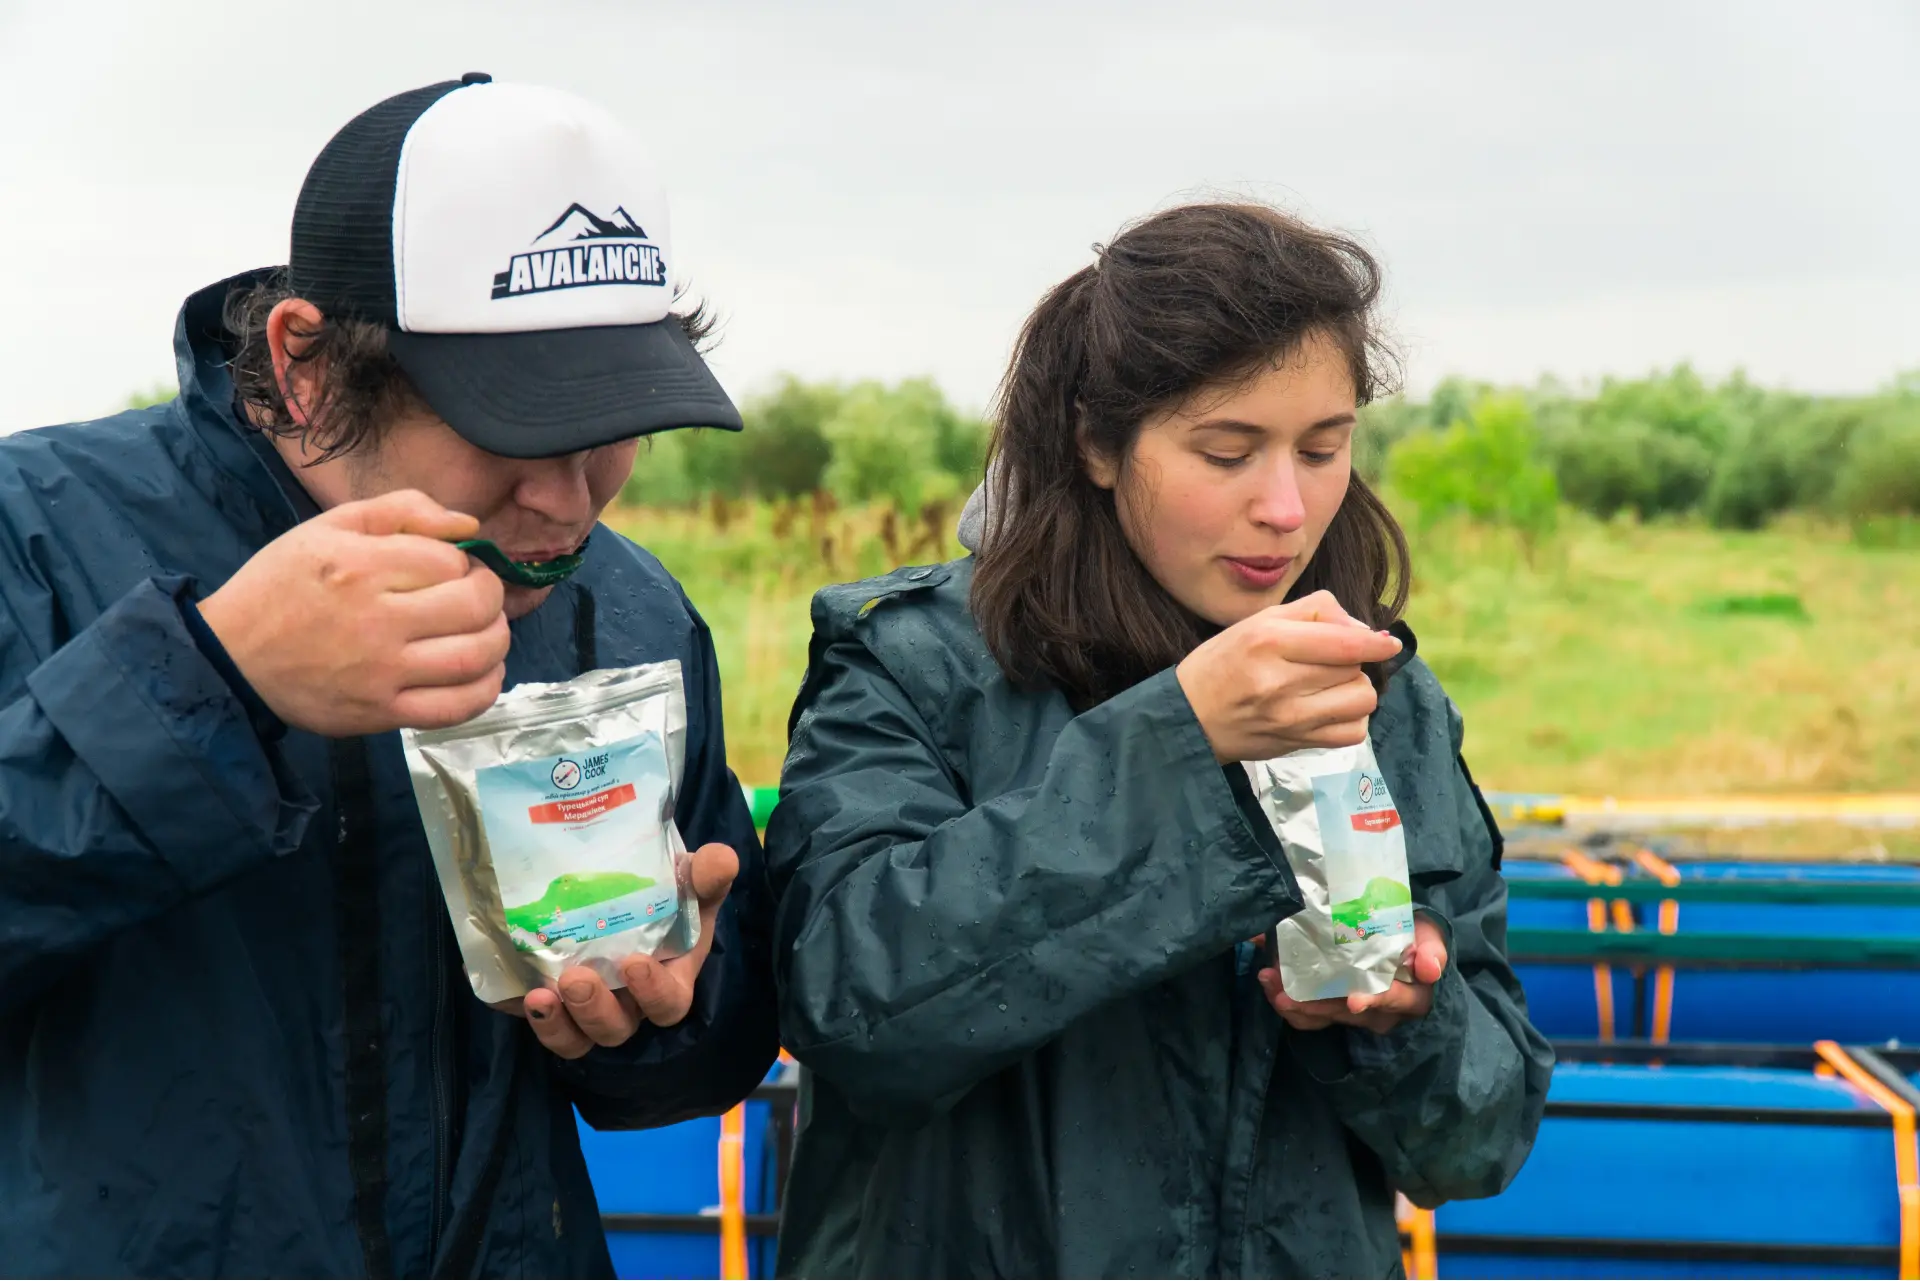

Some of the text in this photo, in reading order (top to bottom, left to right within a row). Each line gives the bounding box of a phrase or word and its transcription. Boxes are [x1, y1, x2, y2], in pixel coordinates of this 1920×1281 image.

[509, 244, 660, 292] AVALANCHE
[583, 754, 608, 769] JAMES
[585, 766, 605, 779] COOK
[557, 793, 609, 812] Турецький суп
